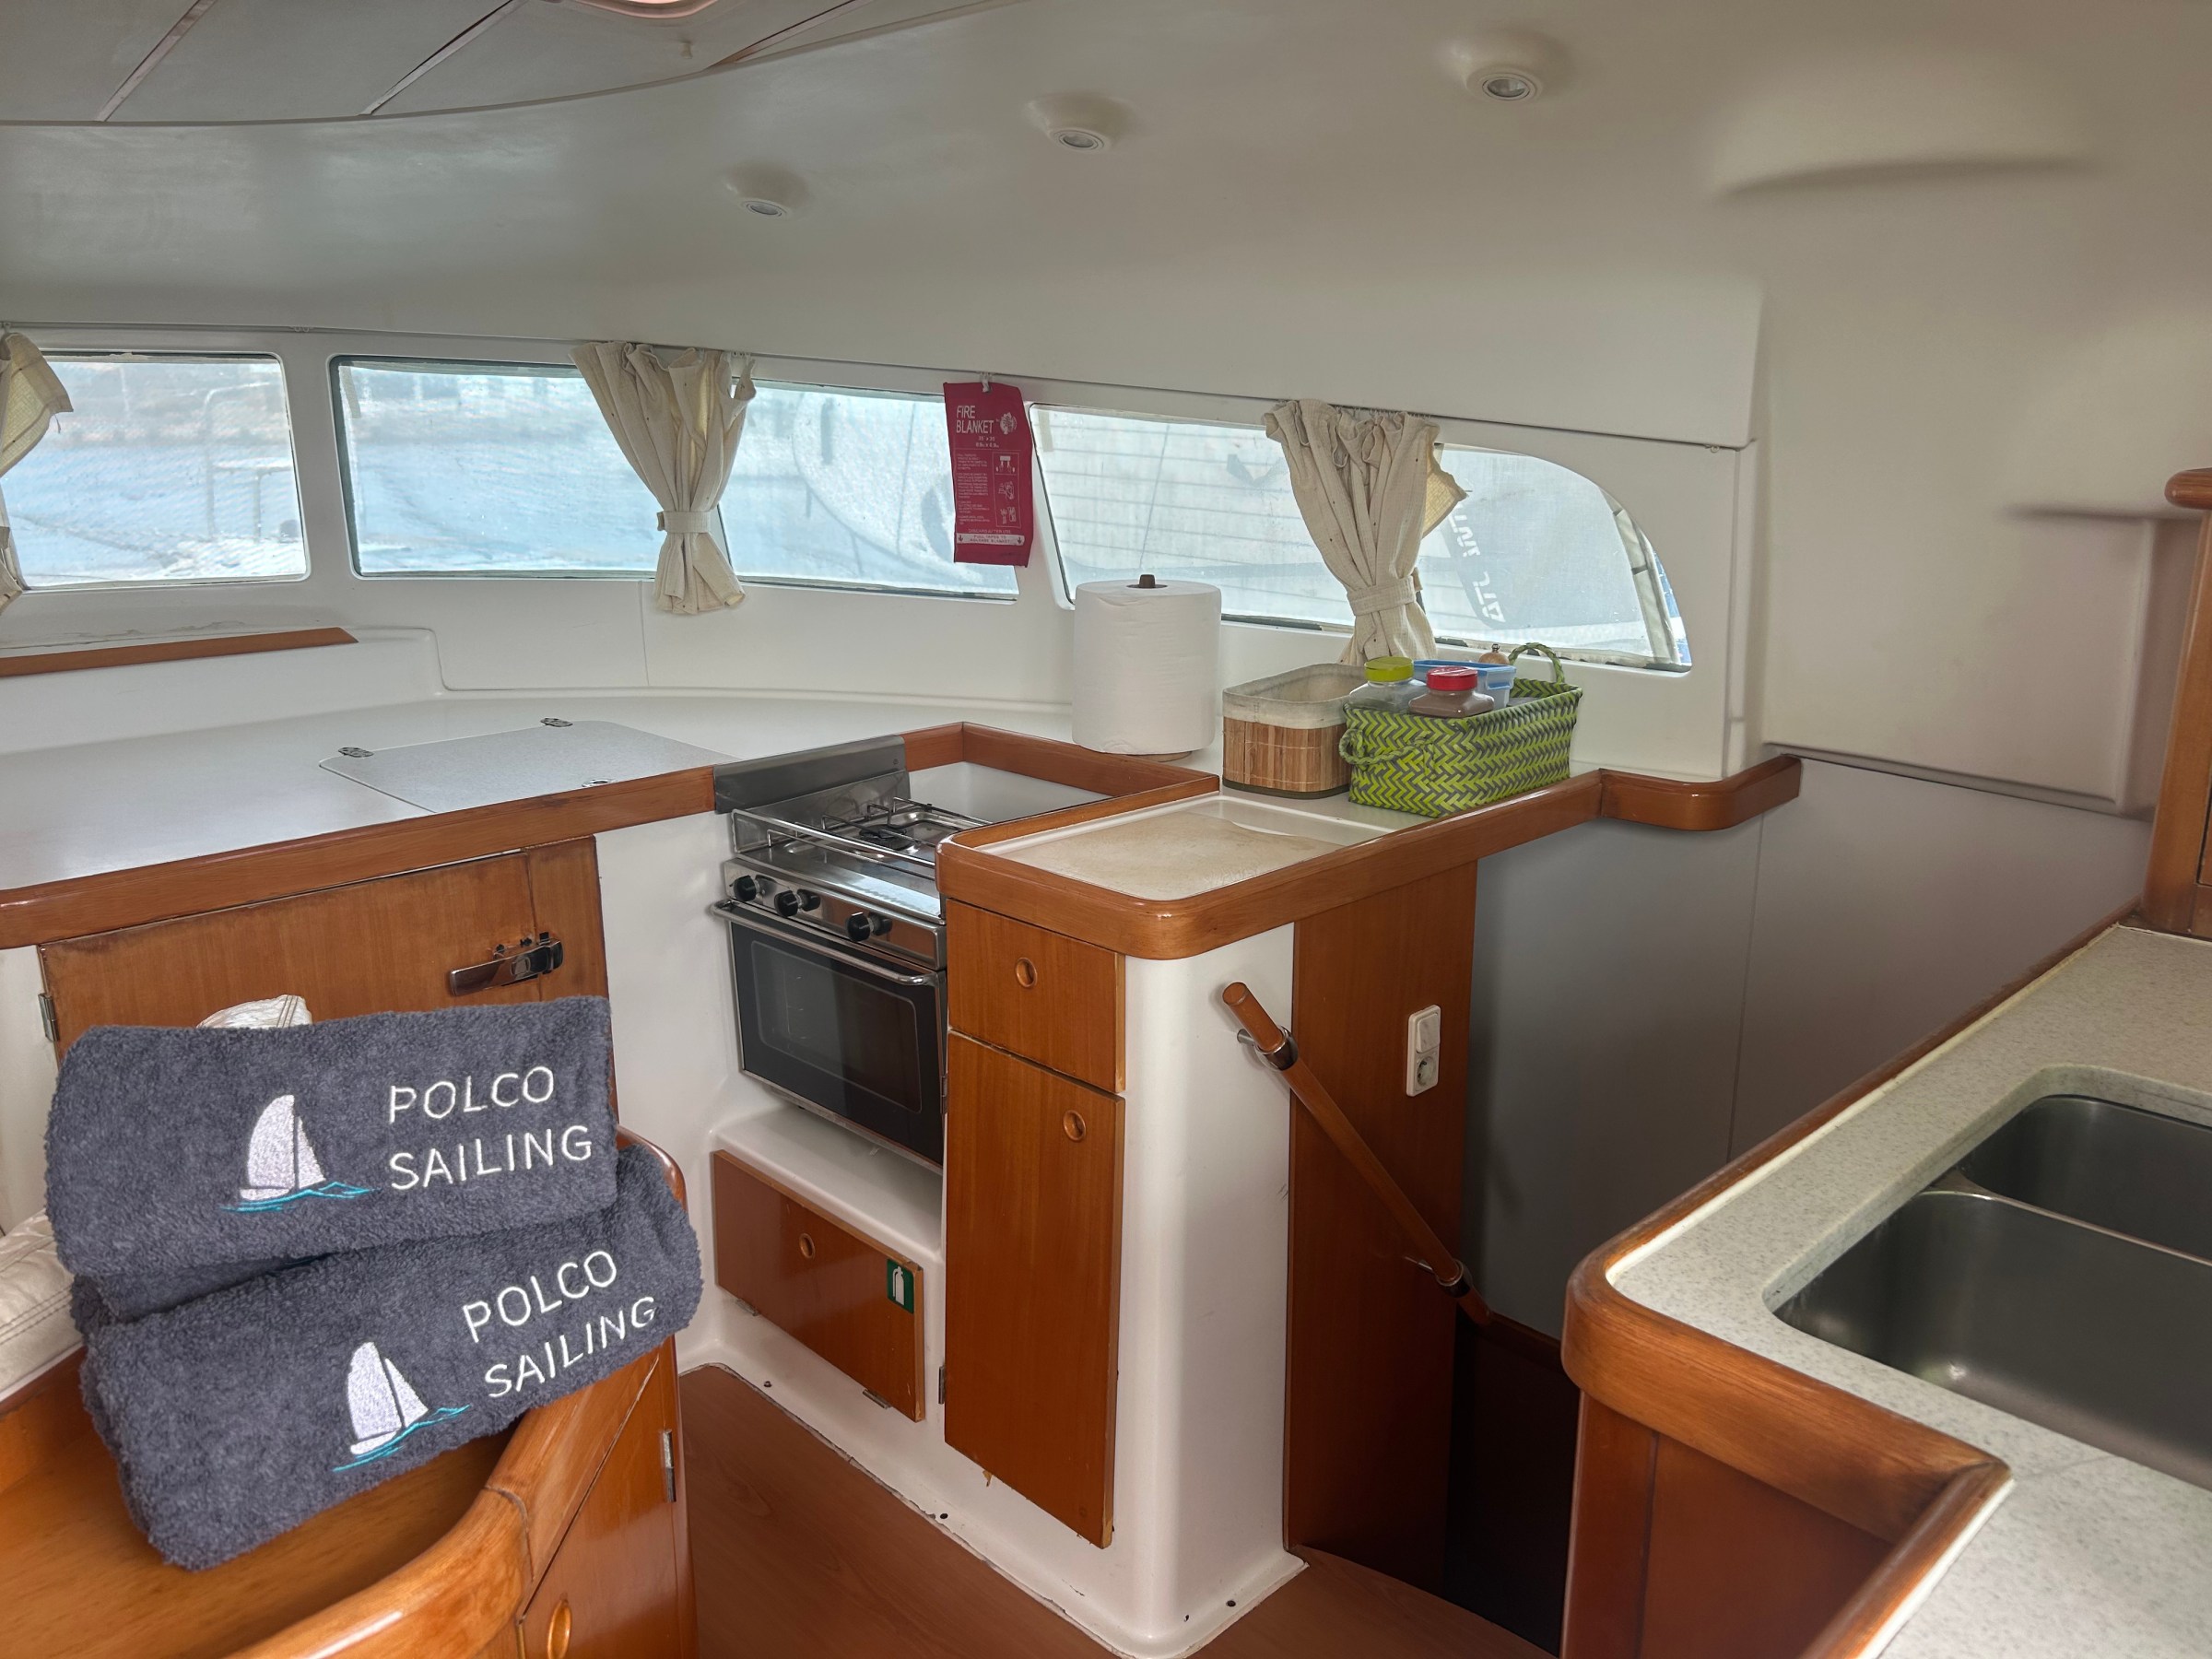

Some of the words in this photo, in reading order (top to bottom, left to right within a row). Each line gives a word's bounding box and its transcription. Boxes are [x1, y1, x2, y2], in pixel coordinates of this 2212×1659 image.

[956, 405, 976, 419] FIRE
[956, 419, 994, 434] BLANKET
[389, 1065, 555, 1124] POLCO
[388, 1124, 594, 1191] SAILING
[462, 1250, 618, 1344] POLCO
[484, 1296, 656, 1398] SAILING
